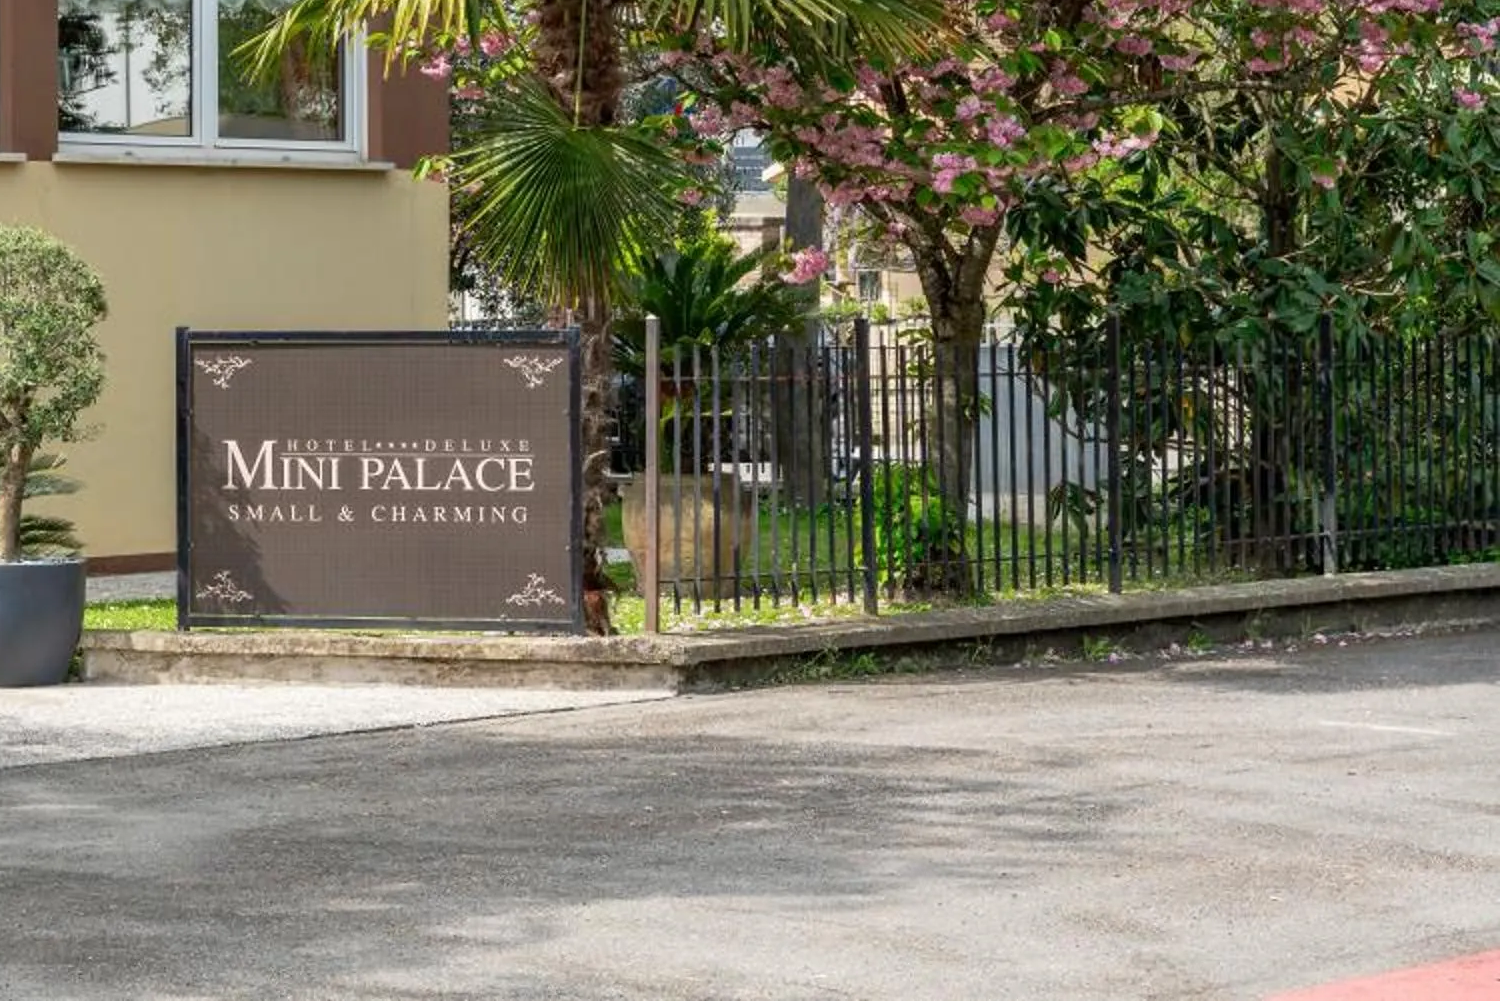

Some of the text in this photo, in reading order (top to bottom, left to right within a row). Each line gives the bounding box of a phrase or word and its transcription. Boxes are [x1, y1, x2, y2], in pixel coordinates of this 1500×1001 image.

[287, 439, 531, 452] HOTEL DELUXE
[222, 439, 535, 492] MINI PALACE
[228, 504, 528, 523] SMALL & CHARMING
